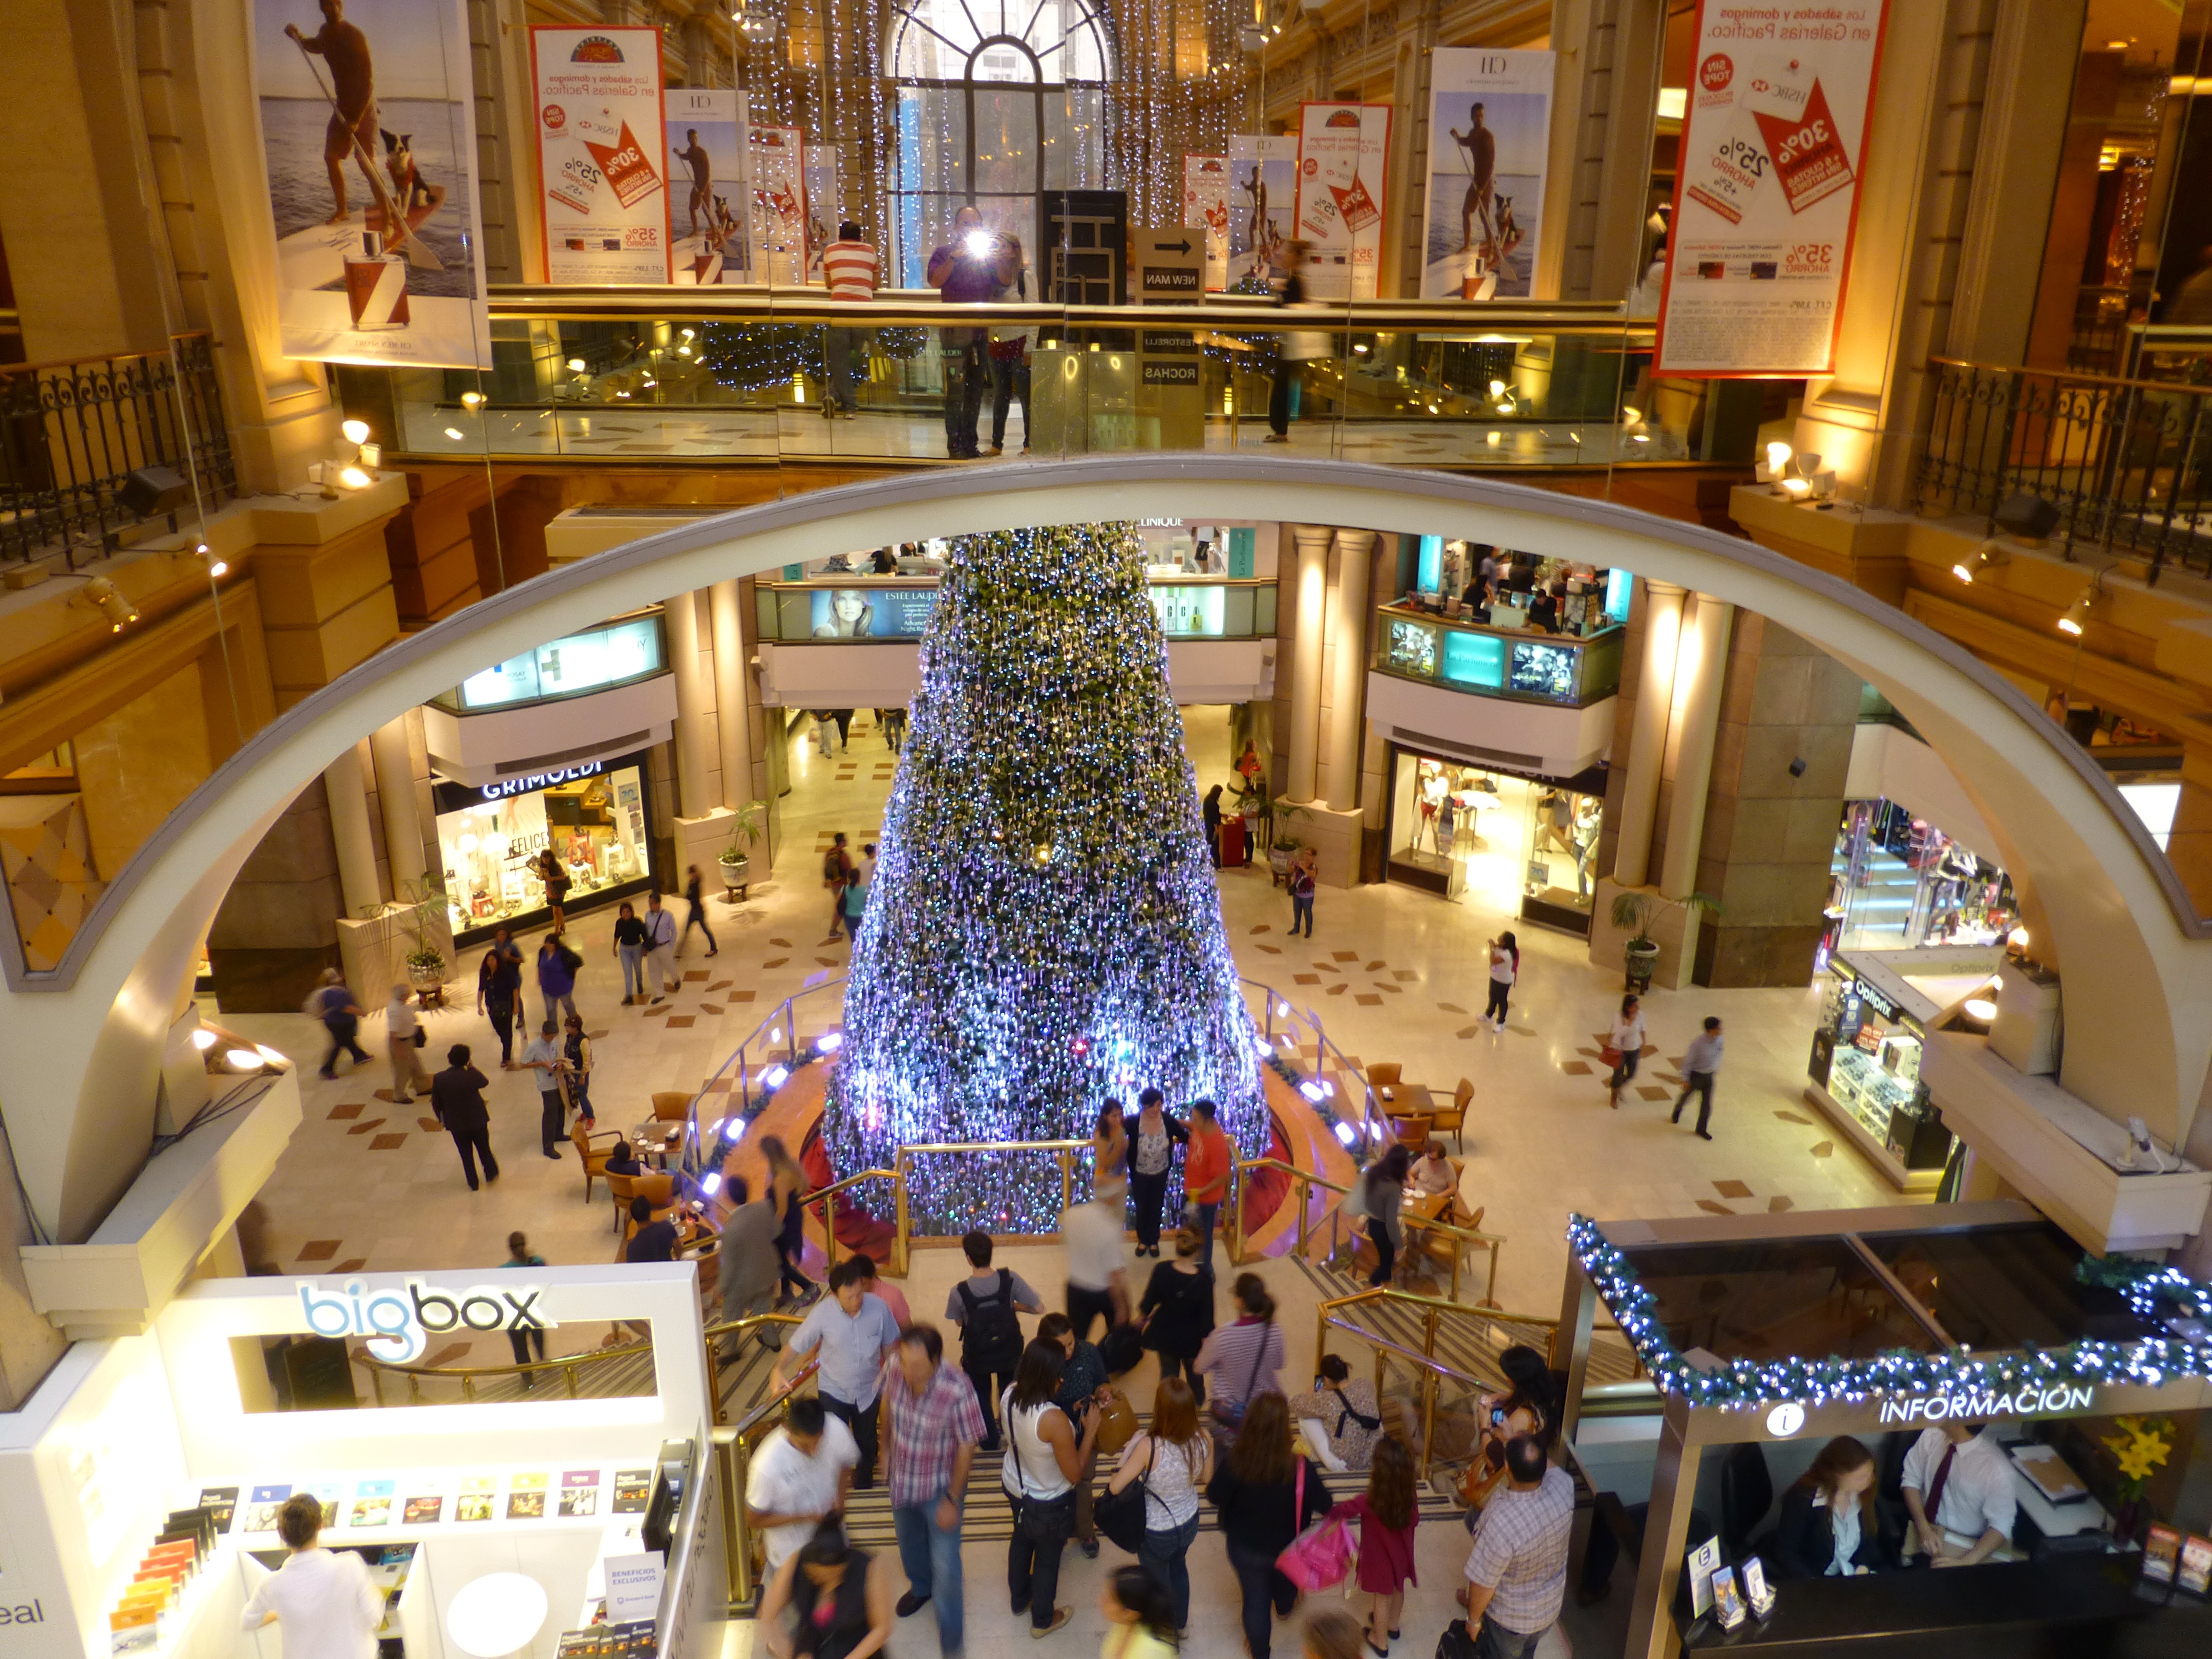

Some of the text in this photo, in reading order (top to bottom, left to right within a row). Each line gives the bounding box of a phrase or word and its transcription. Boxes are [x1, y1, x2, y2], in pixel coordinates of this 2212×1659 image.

[912, 592, 940, 601] LAUDE
[1856, 980, 1891, 1018] Optiprix
[300, 1283, 544, 1363] bigbox
[1880, 1386, 2094, 1423] INFORMACIÓN
[611, 1568, 655, 1578] BENEFICIOS
[612, 1575, 656, 1585] EXCLUSIVOS
